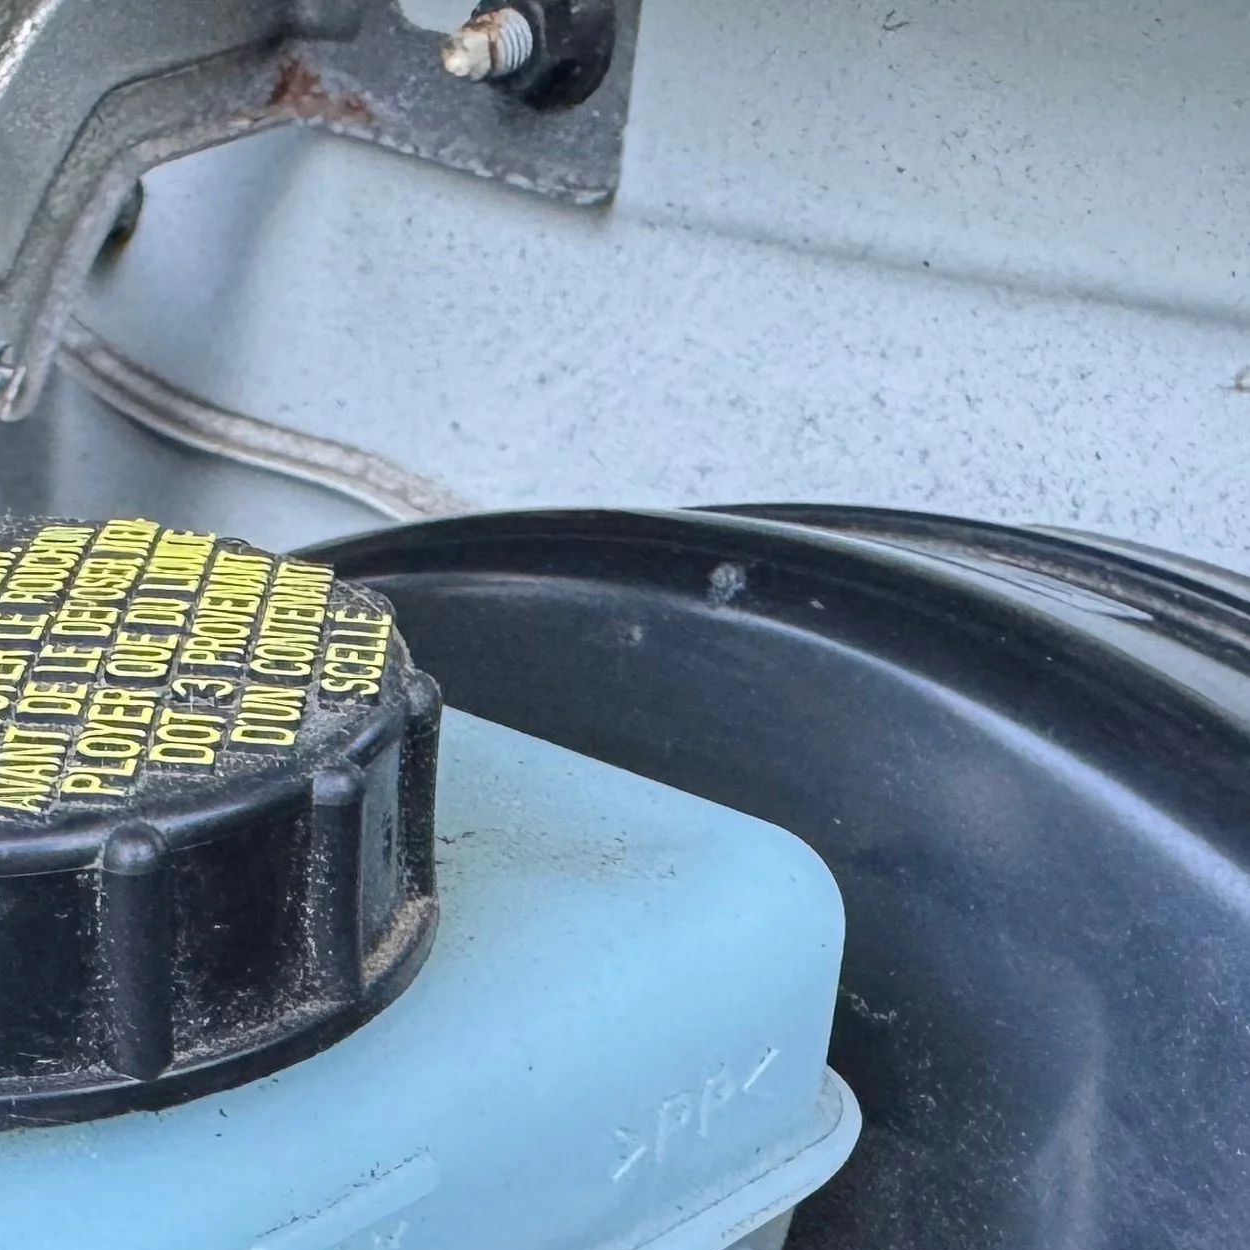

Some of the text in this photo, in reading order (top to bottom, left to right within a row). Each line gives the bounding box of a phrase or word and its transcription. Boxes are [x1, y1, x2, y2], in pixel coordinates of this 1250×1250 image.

[124, 597, 192, 627] DU
[35, 645, 105, 676] LE
[105, 632, 180, 679] QUE
[150, 550, 274, 765] DOT 3 PROVENANT
[230, 561, 335, 745] D'UN CONTENANT
[16, 682, 89, 717] DE
[61, 687, 156, 796] PLOYER
